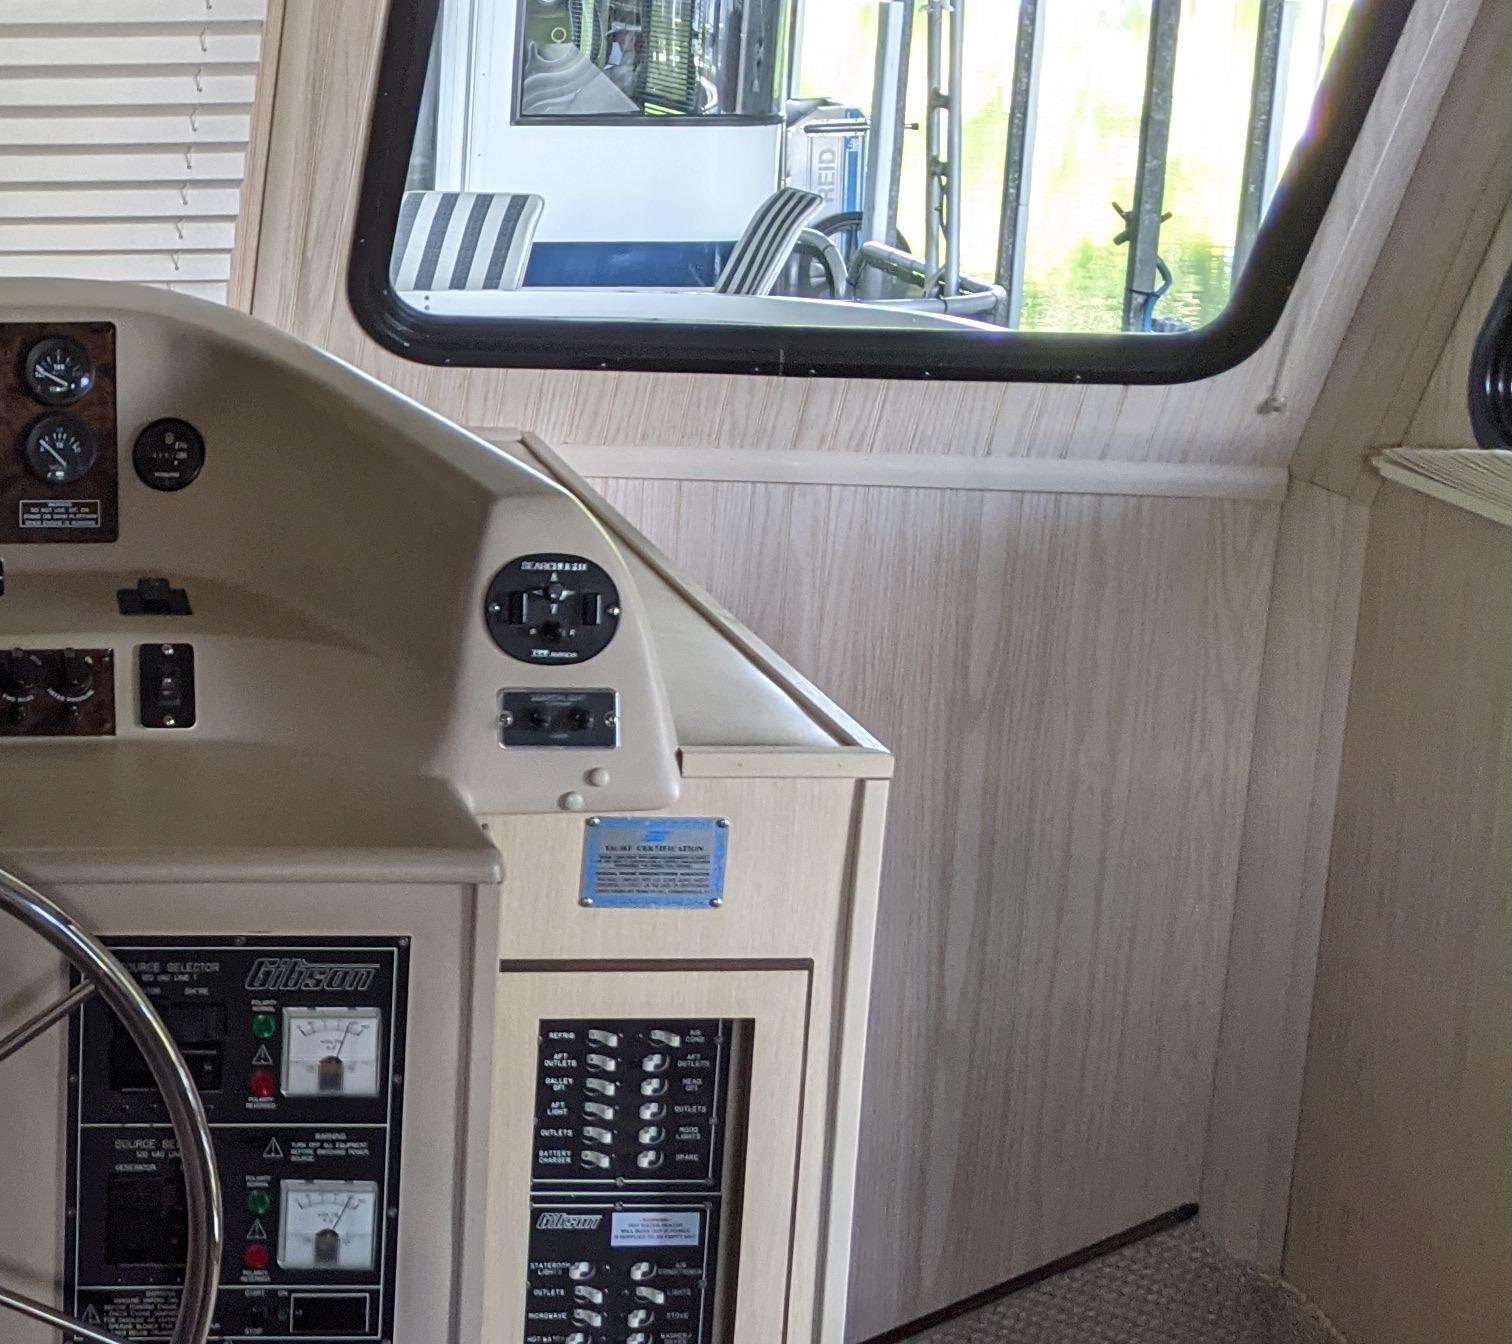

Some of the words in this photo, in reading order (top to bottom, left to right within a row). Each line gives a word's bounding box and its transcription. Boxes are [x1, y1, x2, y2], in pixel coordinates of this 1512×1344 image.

[166, 962, 220, 972] SELECTOR
[245, 958, 381, 990] Gibson
[544, 1059, 577, 1067] OUTLETS
[546, 1108, 568, 1116] LIGHT
[674, 1105, 707, 1113] OUTLETS
[539, 1129, 573, 1137] OUTLETS
[114, 1139, 156, 1149] SOURCE
[535, 1212, 603, 1229] Gibson
